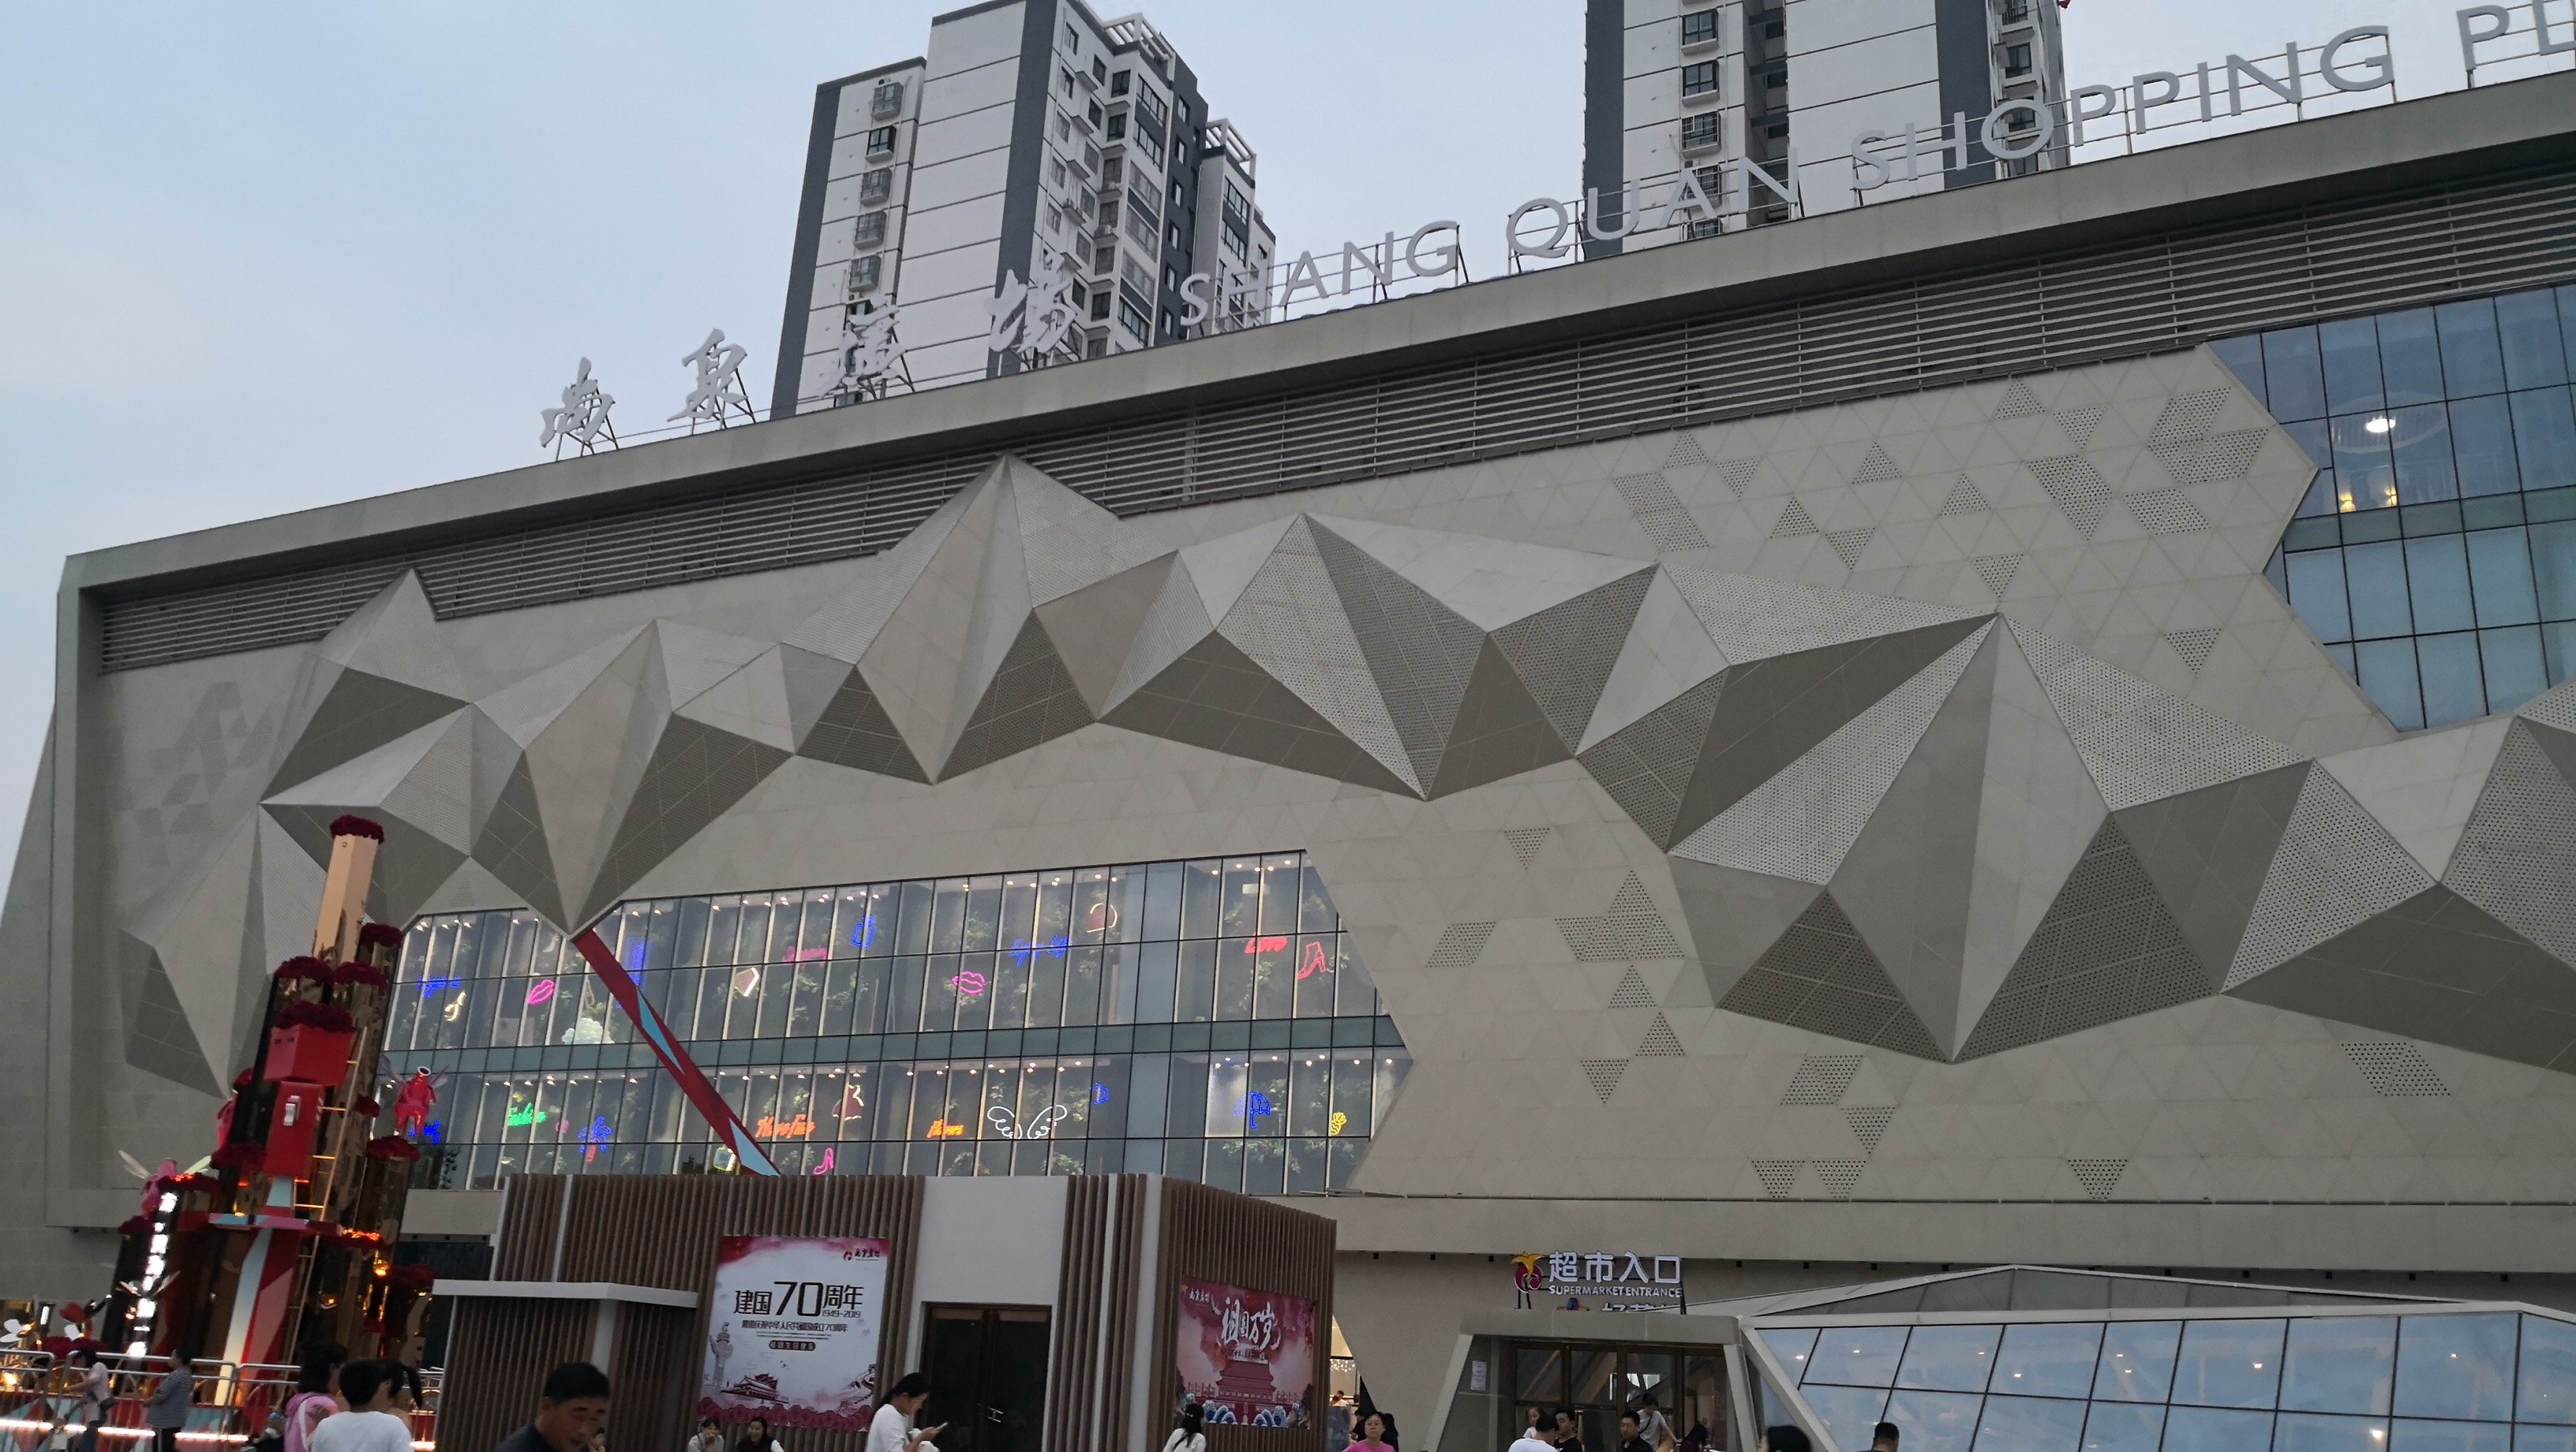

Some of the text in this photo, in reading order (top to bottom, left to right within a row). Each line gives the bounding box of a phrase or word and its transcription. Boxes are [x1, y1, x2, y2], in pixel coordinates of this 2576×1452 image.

[1179, 219, 1459, 327] SHANG
[1506, 146, 1799, 257] QUAN
[1850, 24, 2394, 190] SHOPPING
[1548, 1250, 1683, 1284] 超市入口
[733, 1282, 864, 1316] 建国70周年
[1548, 1285, 1682, 1298] SUPERMARKET ENTRANCE
